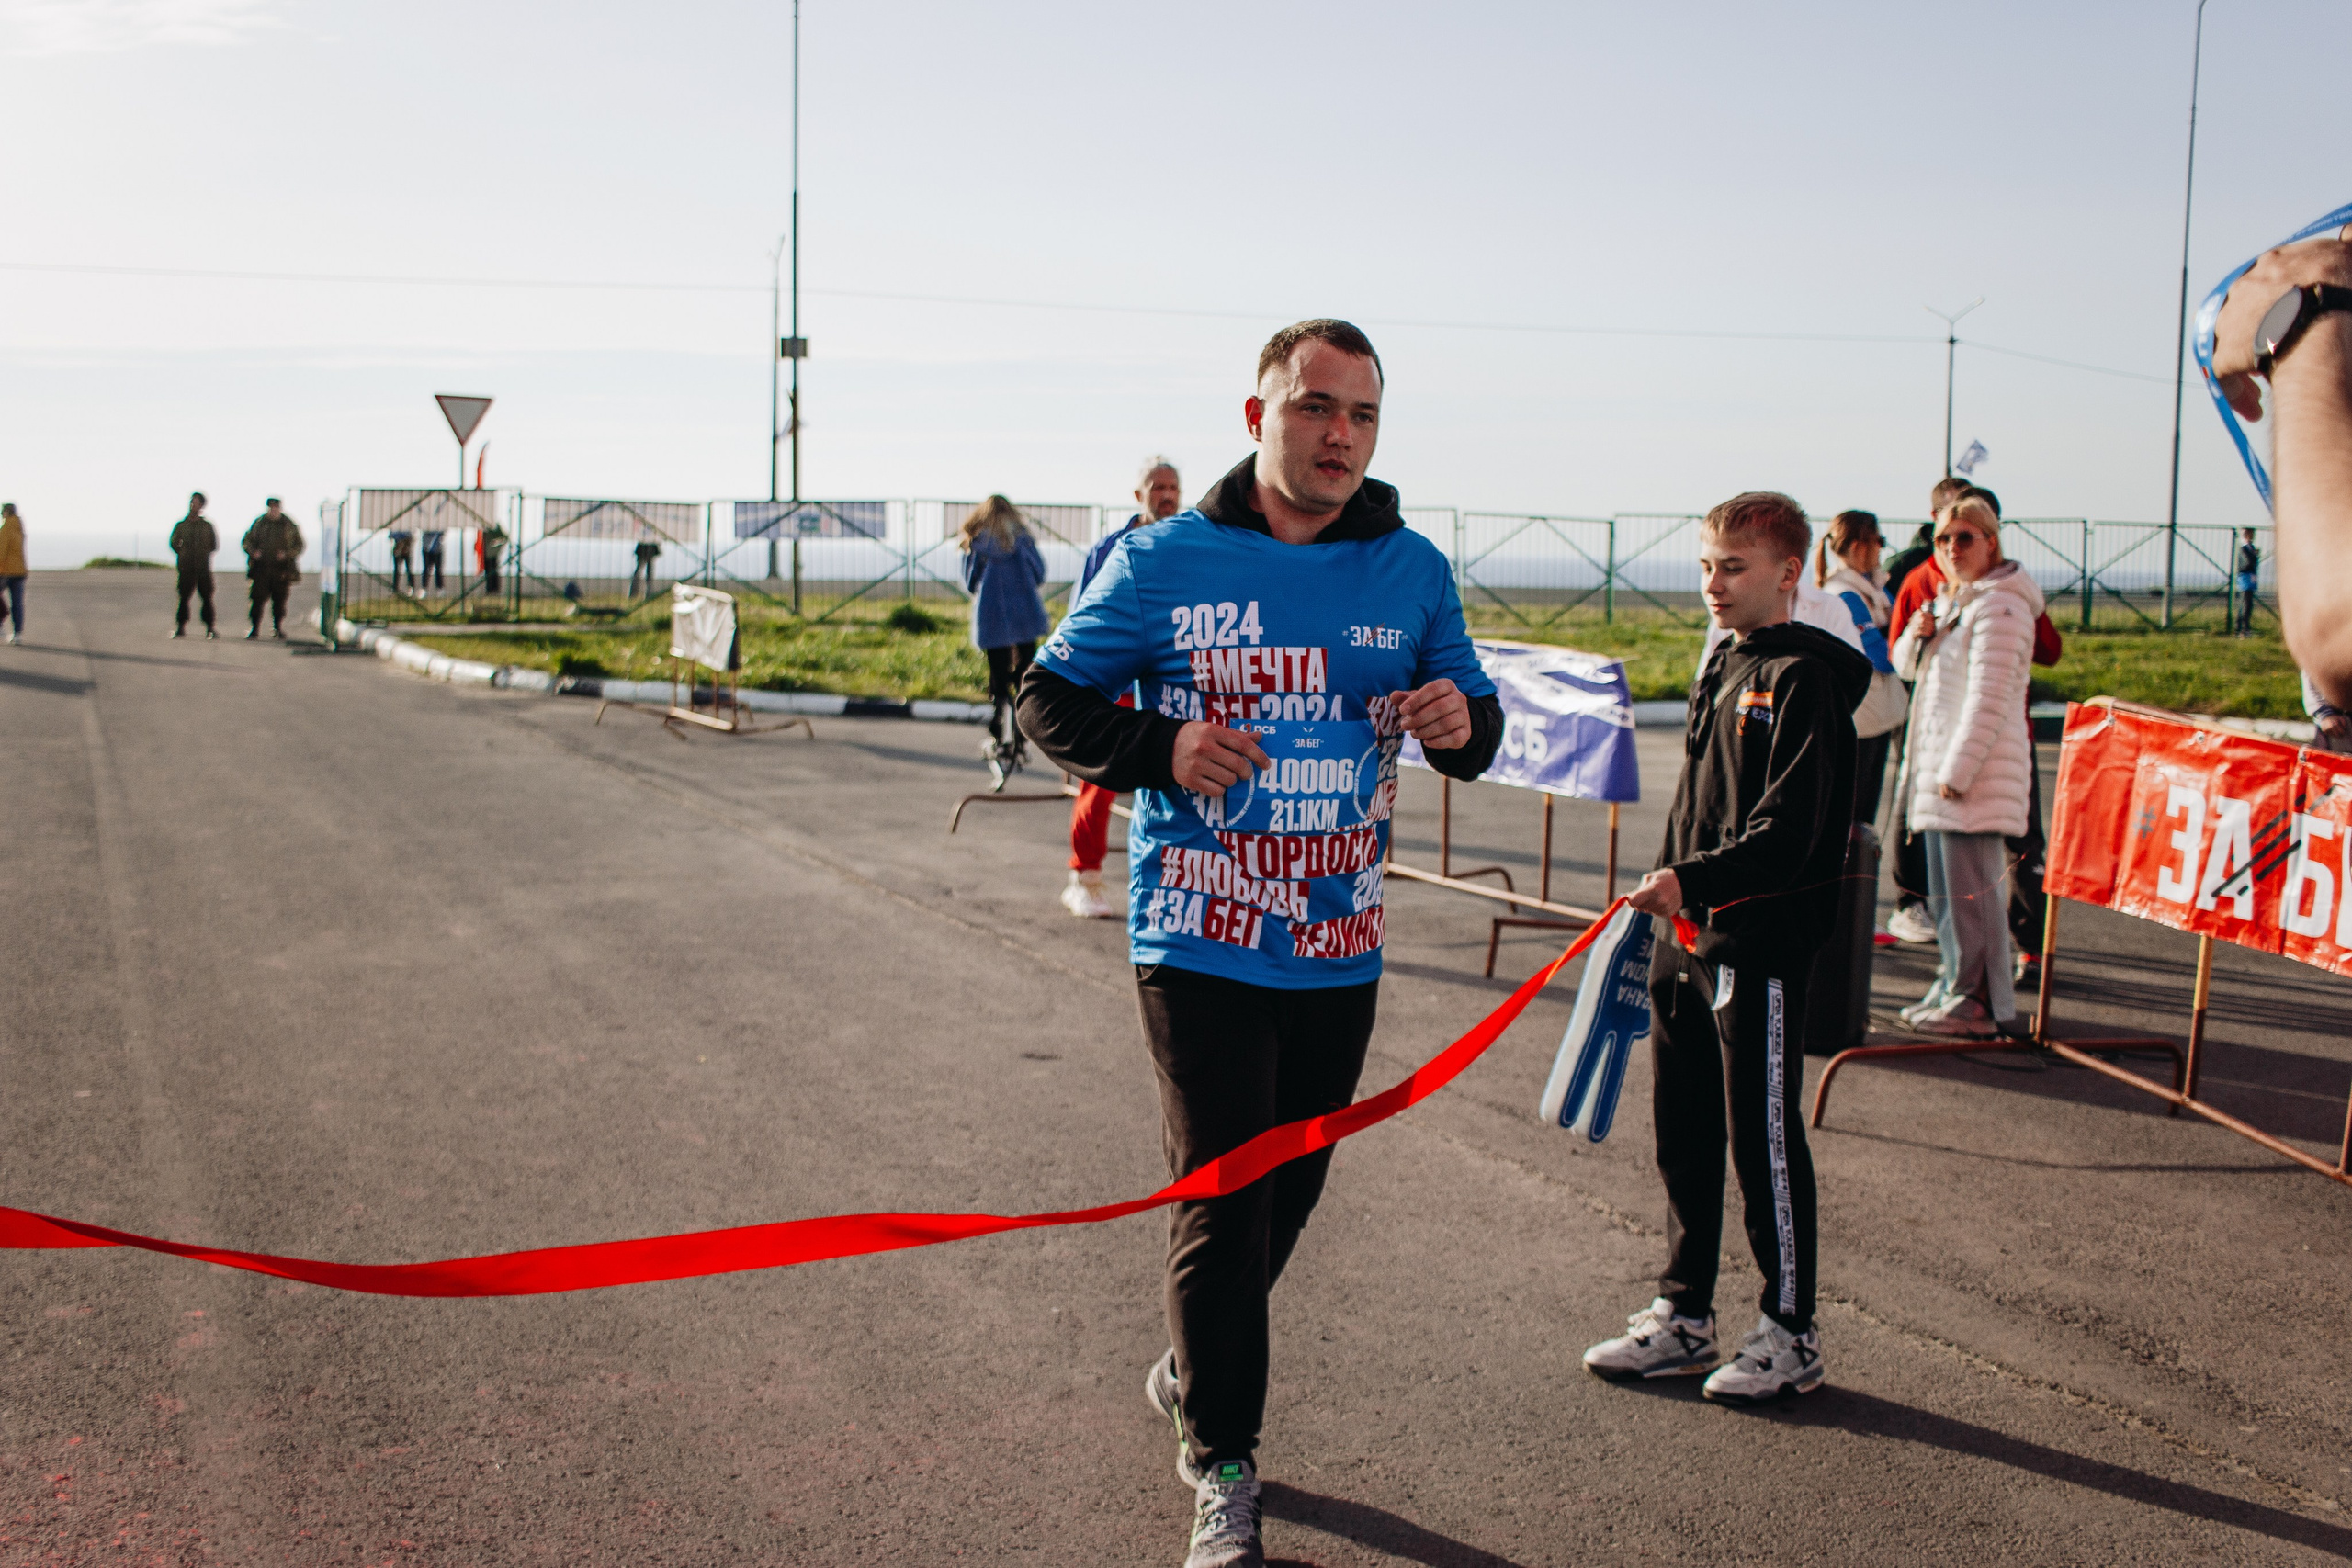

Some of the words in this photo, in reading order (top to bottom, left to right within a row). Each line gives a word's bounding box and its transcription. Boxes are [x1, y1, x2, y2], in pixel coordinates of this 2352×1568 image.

[1171, 600, 1264, 651] 2024
[1192, 647, 1327, 694] #МЕЧТА
[1501, 710, 1548, 763] СБ
[1258, 758, 1355, 795] 40006
[1146, 888, 1263, 950] #ЗАБЕГ
[1287, 905, 1385, 959] #ЕДИНСТ
